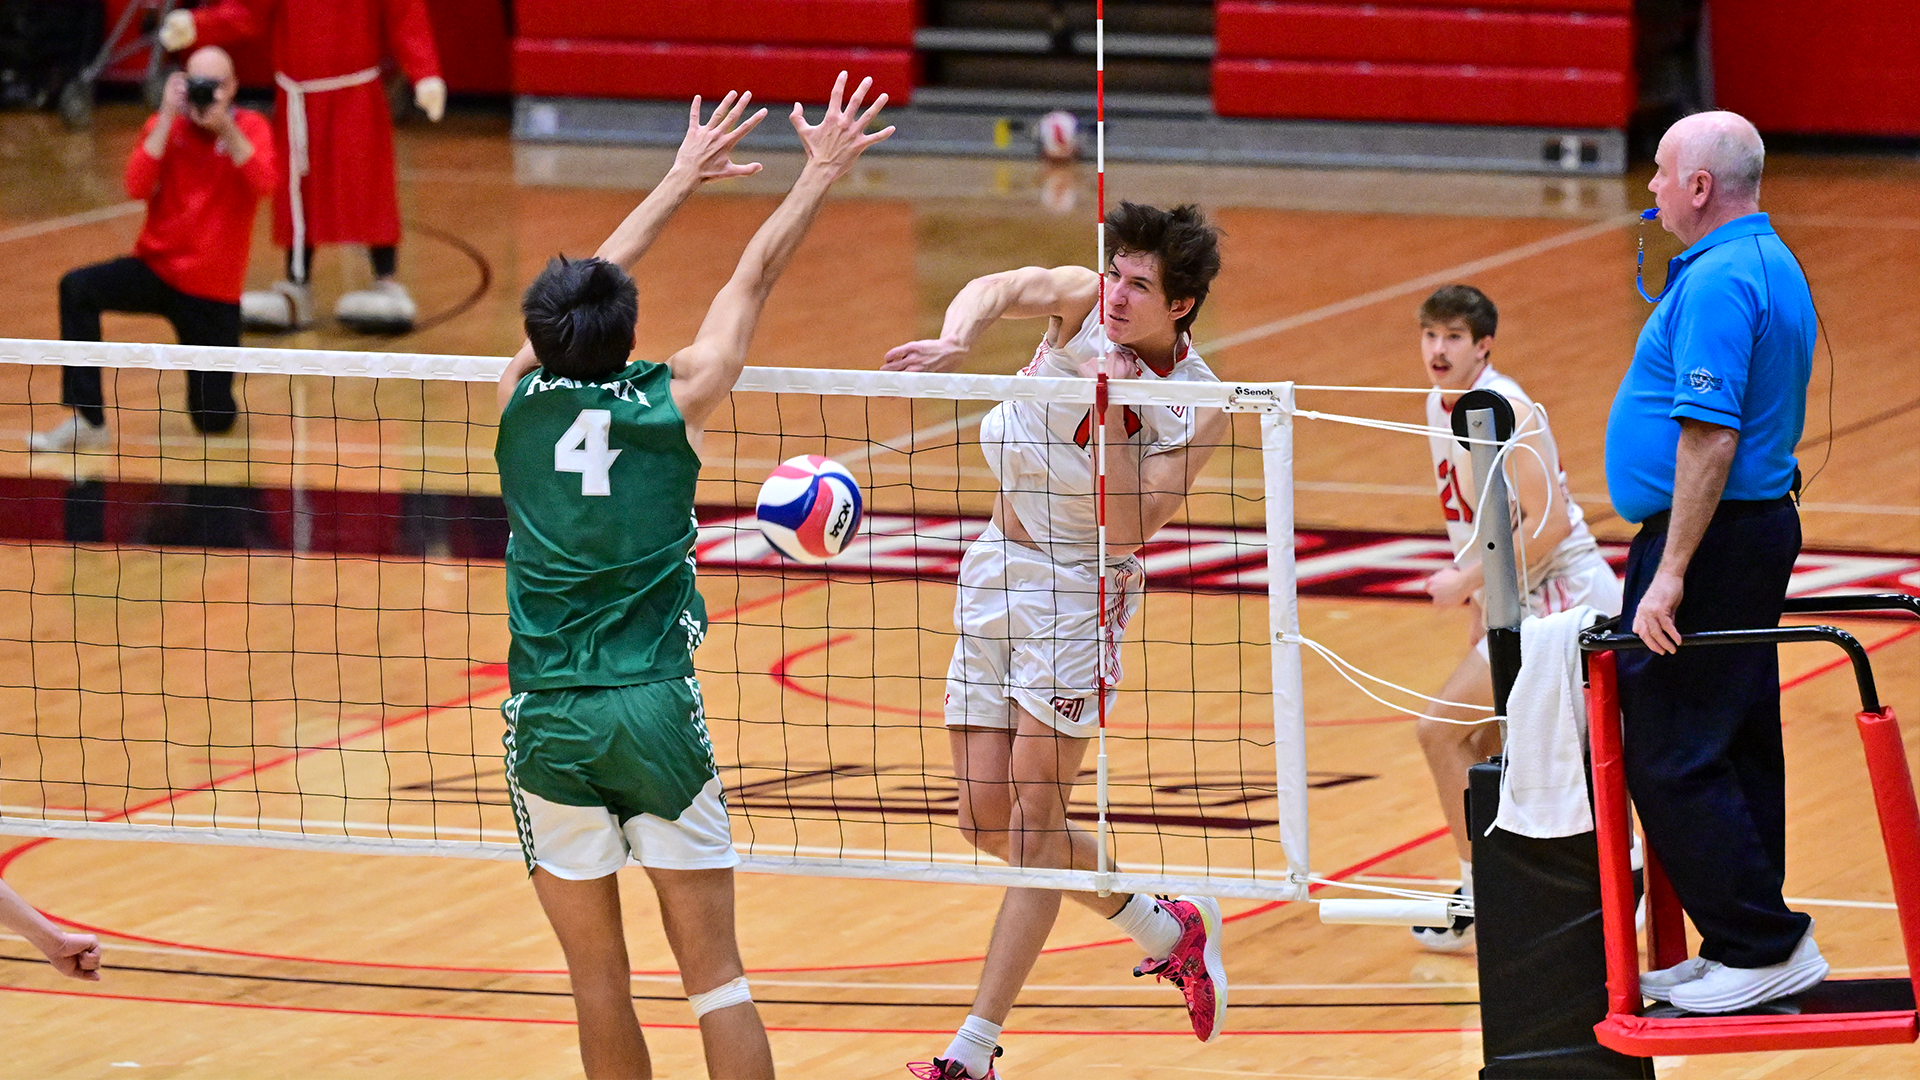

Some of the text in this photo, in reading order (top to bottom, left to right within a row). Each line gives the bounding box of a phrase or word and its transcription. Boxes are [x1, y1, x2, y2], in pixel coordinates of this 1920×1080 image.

[1243, 388, 1274, 396] Senoh
[555, 409, 622, 496] 4
[1438, 459, 1474, 524] 21
[829, 499, 851, 539] NCAA
